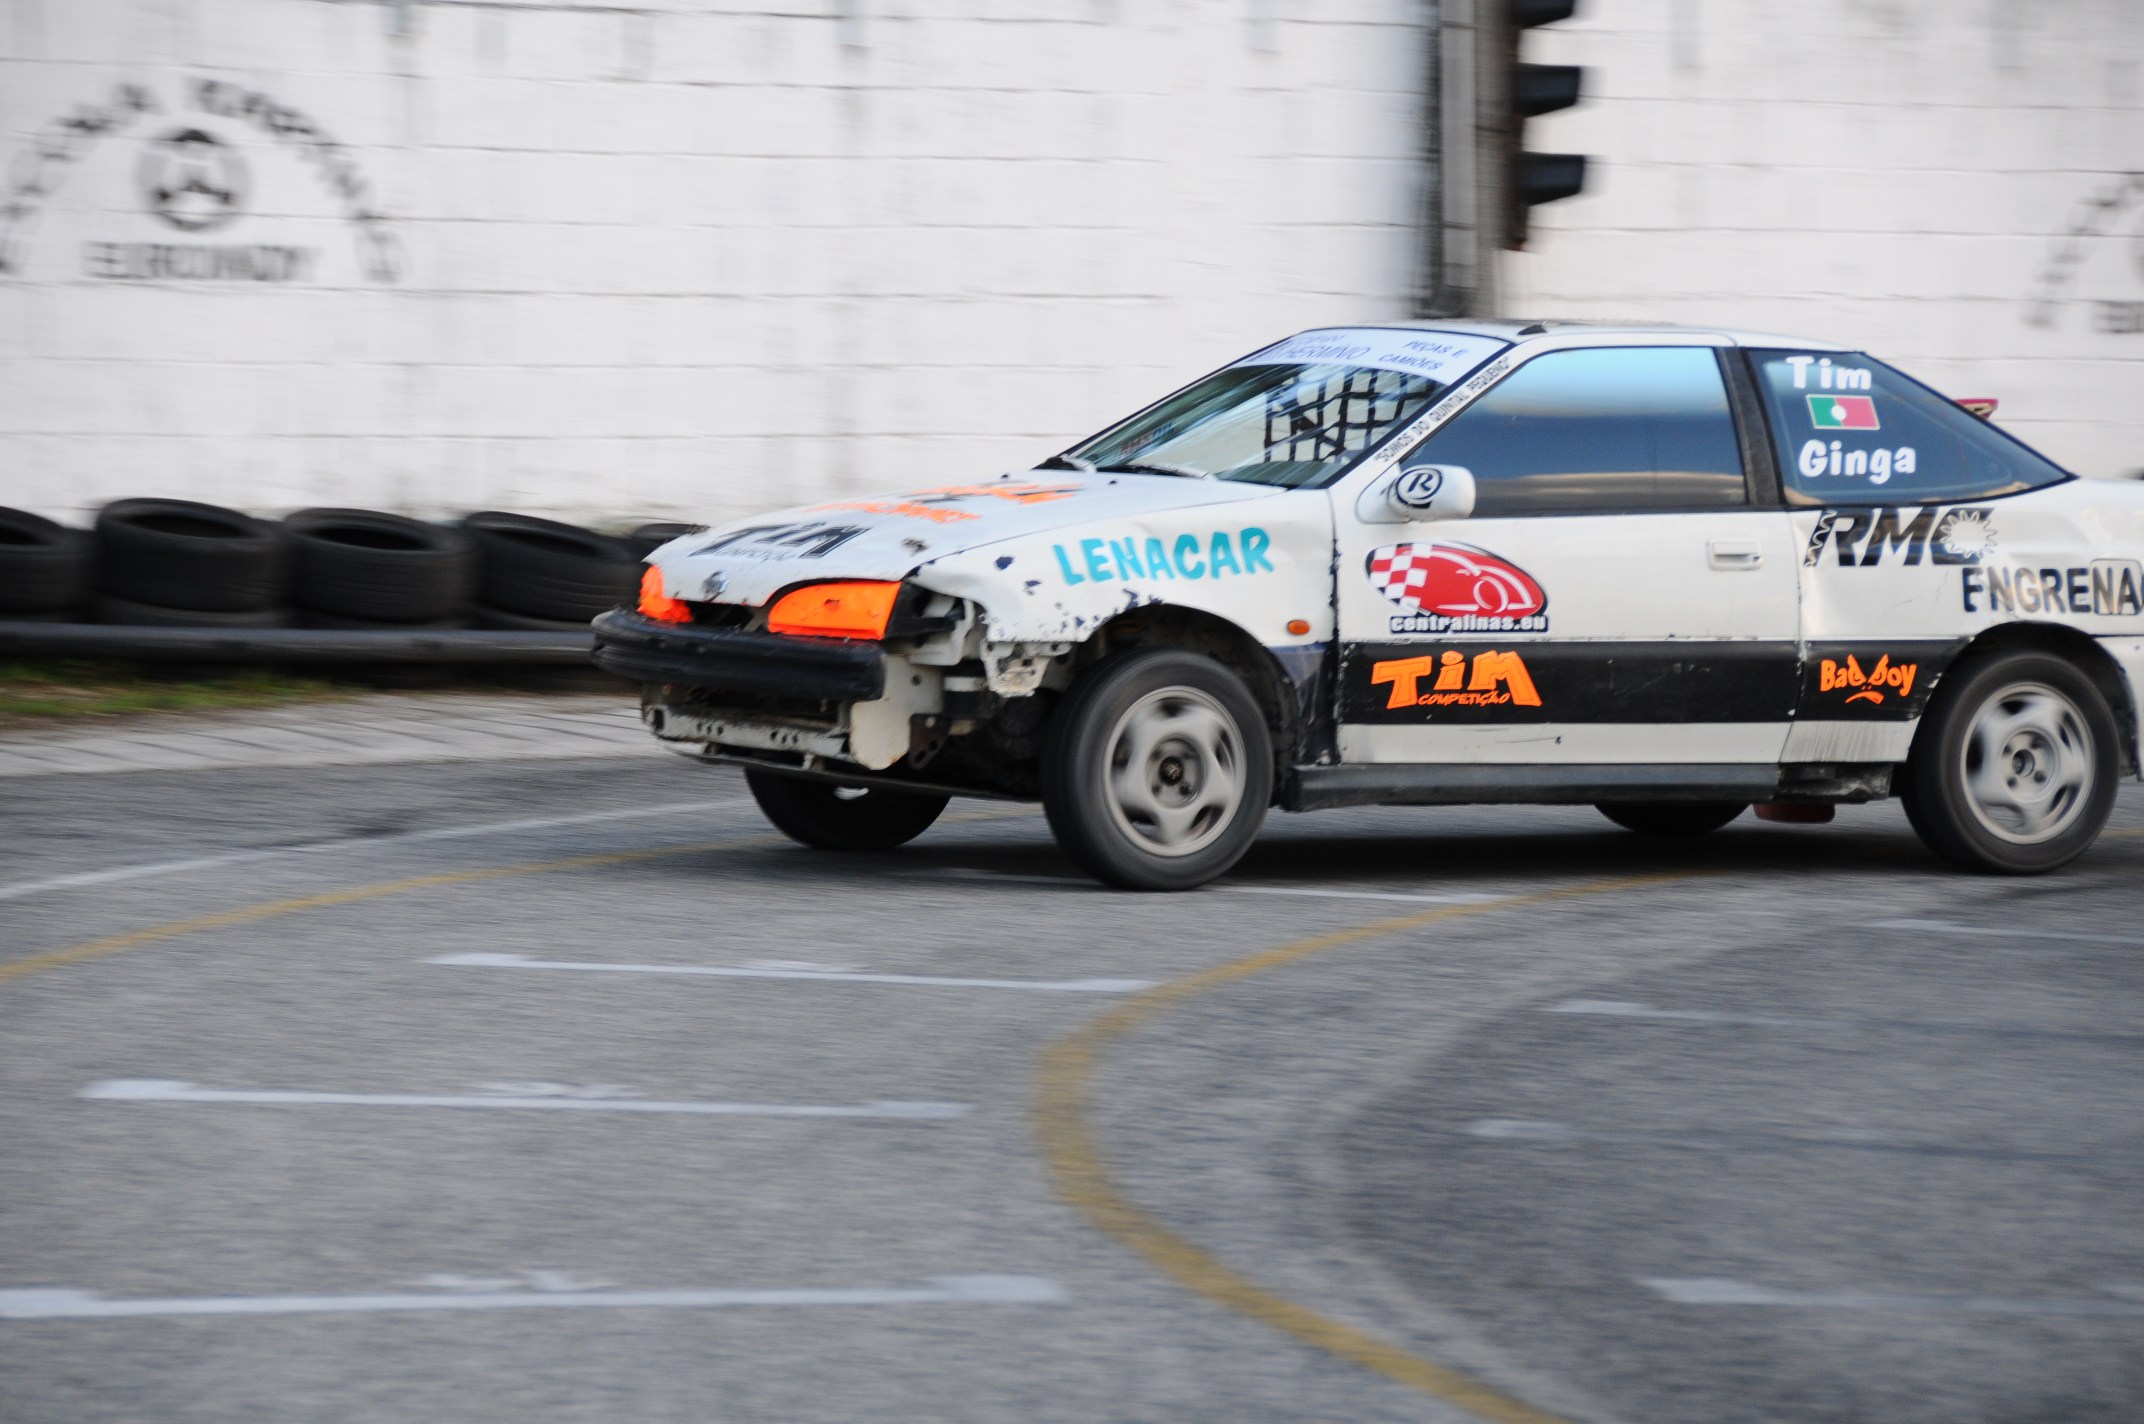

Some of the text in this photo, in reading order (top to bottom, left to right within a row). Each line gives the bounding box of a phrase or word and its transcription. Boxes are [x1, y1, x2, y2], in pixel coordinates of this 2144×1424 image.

[1785, 355, 1873, 390] Tim
[1798, 439, 1917, 485] Ginga
[1051, 526, 1274, 586] LENACAR
[1961, 566, 2144, 615] ENGRENA
[1390, 613, 1547, 633] centralinas.eu
[1418, 690, 1511, 707] COMPETIÇÃO
